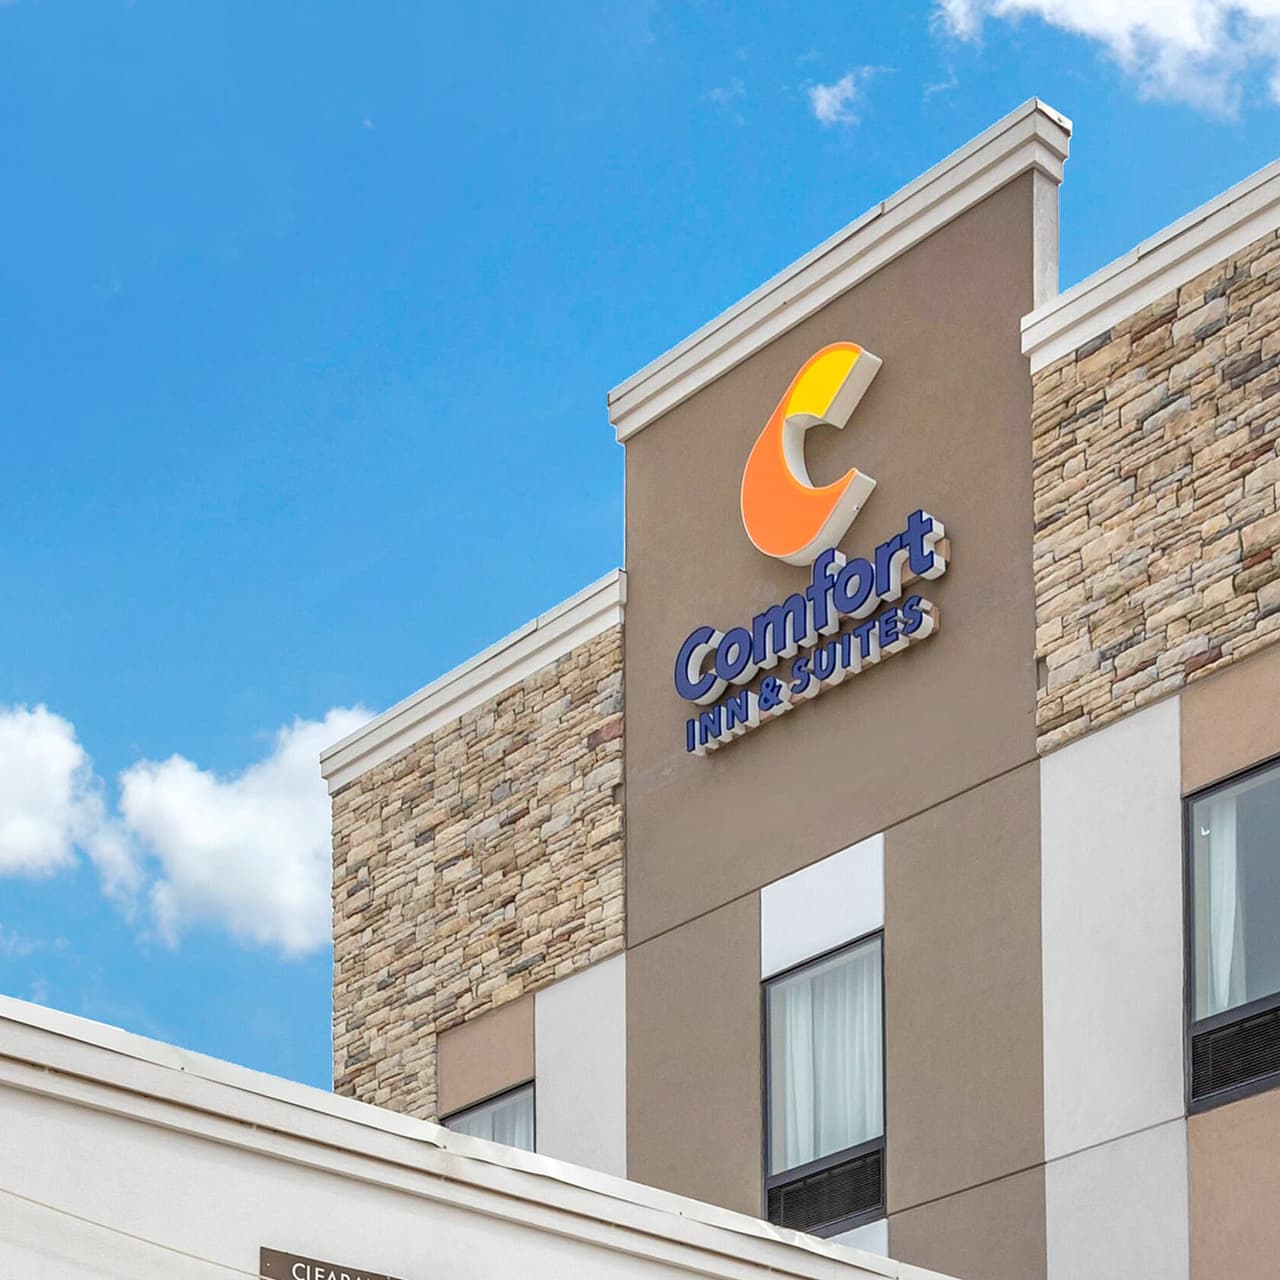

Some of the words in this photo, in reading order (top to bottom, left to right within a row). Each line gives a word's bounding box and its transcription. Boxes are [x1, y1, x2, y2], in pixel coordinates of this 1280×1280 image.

[741, 341, 883, 566] C
[674, 509, 946, 704] Comfort
[686, 690, 757, 756] INN
[758, 675, 792, 714] &
[790, 596, 937, 694] SUITES
